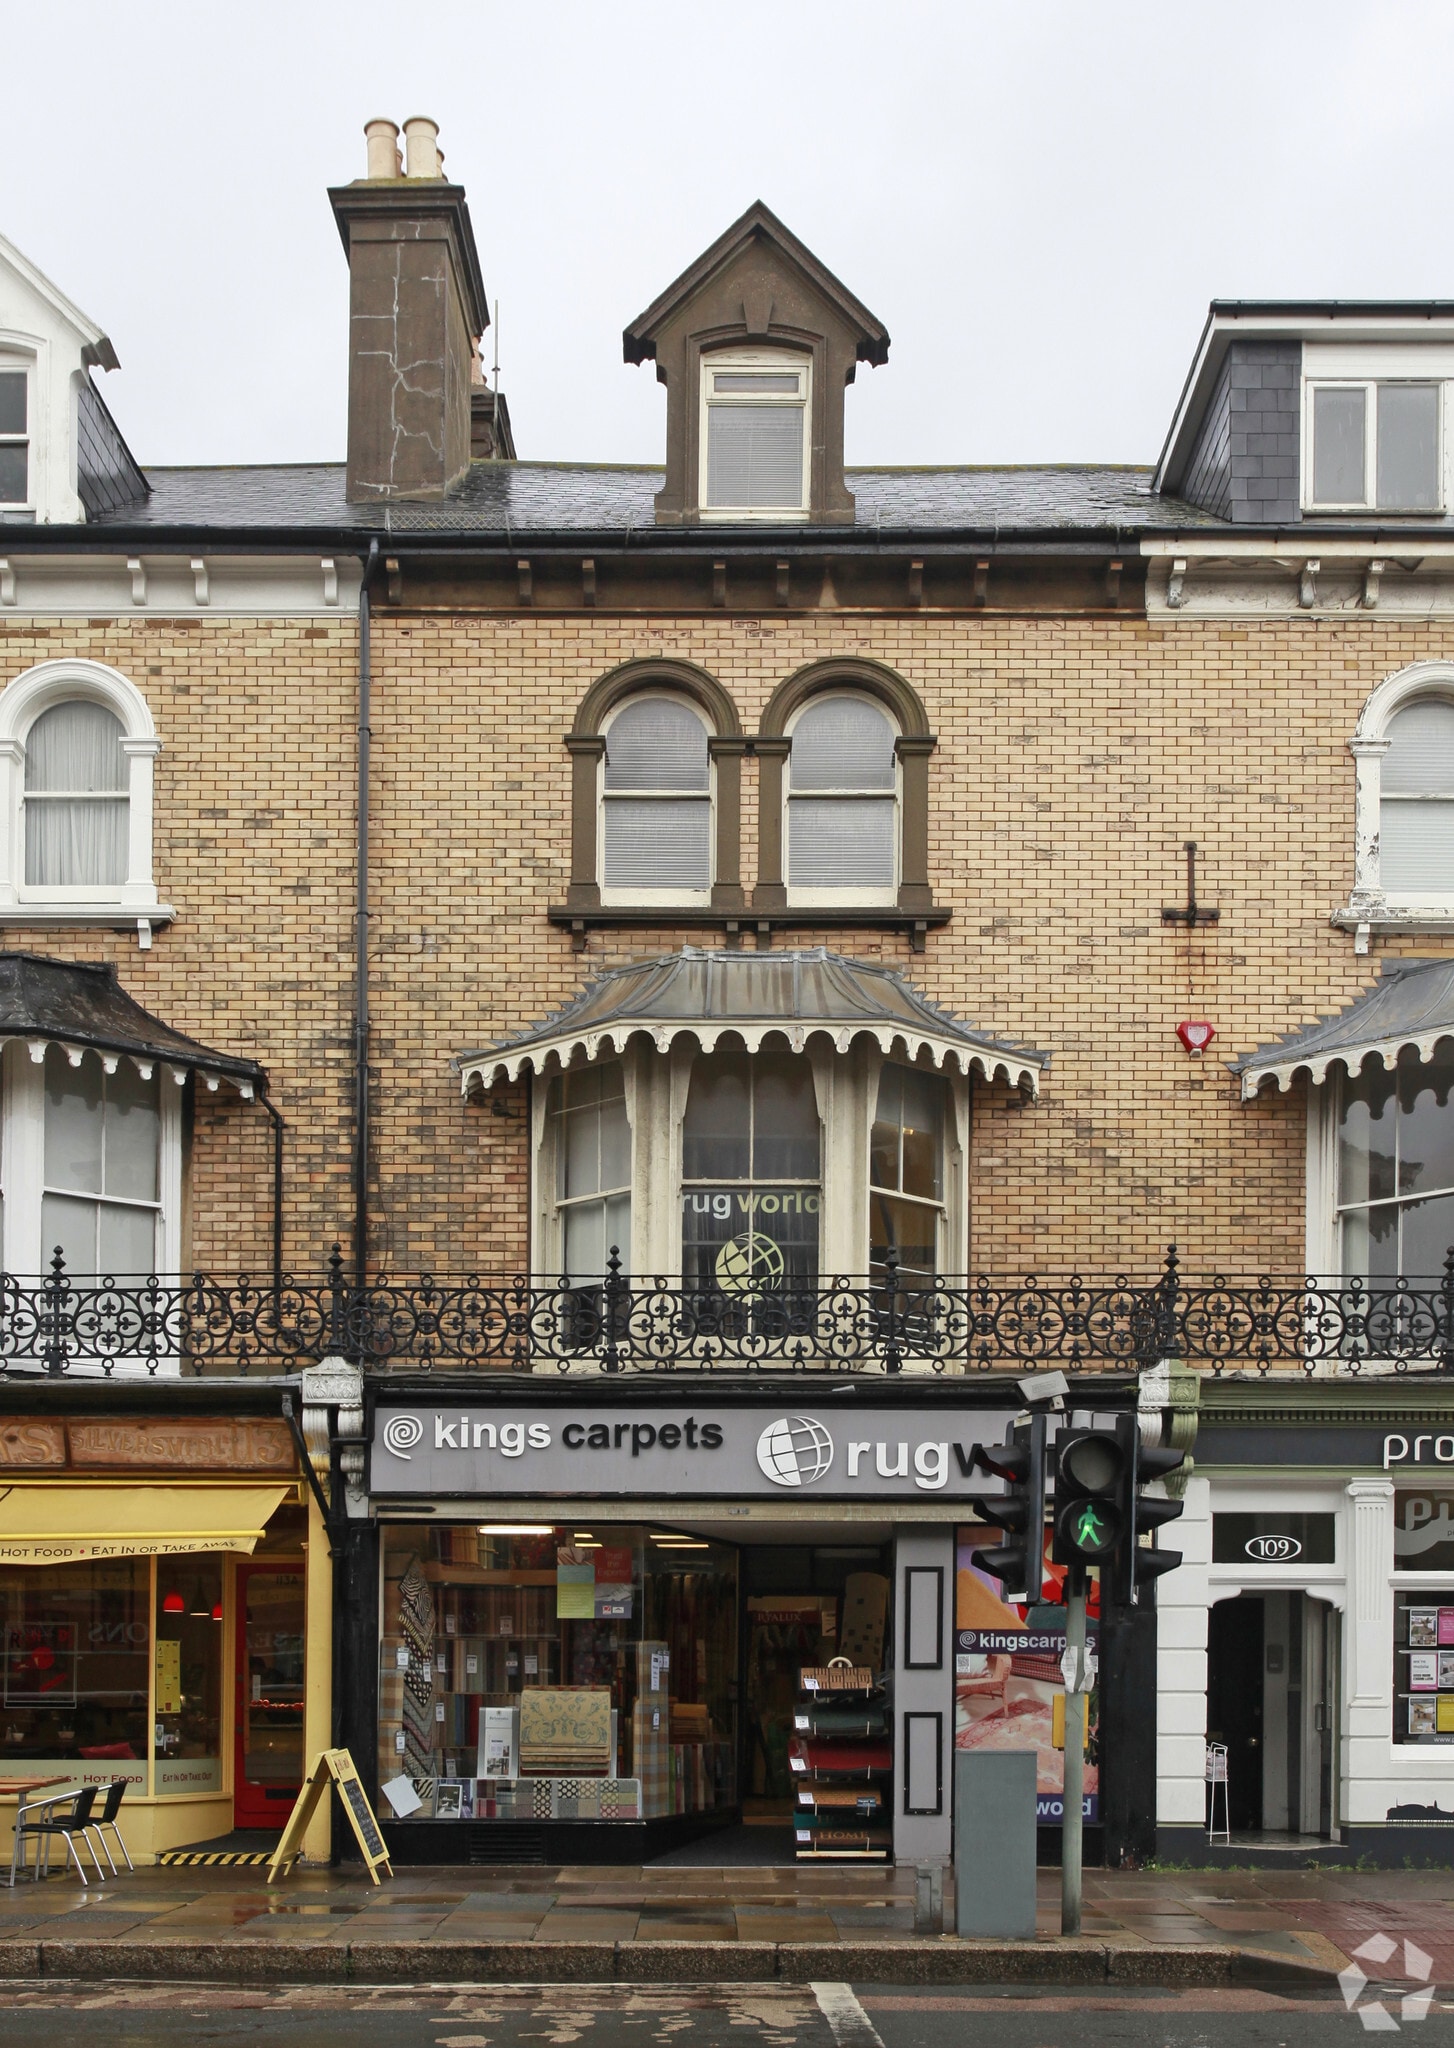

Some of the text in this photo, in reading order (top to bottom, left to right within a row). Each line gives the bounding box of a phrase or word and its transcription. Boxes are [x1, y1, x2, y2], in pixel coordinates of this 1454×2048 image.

[682, 1194, 731, 1220] rug
[435, 1416, 724, 1457] kings carpets
[34, 1548, 73, 1557] FOOD
[91, 1546, 117, 1555] EAT
[121, 1546, 135, 1554] IN
[140, 1546, 158, 1554] OR
[162, 1544, 196, 1552] TAKE
[200, 1541, 237, 1549] AWAY
[1258, 1539, 1289, 1556] 109
[980, 1633, 1096, 1651] kingscarps
[84, 1775, 107, 1783] HOT
[1036, 1798, 1091, 1815] wod
